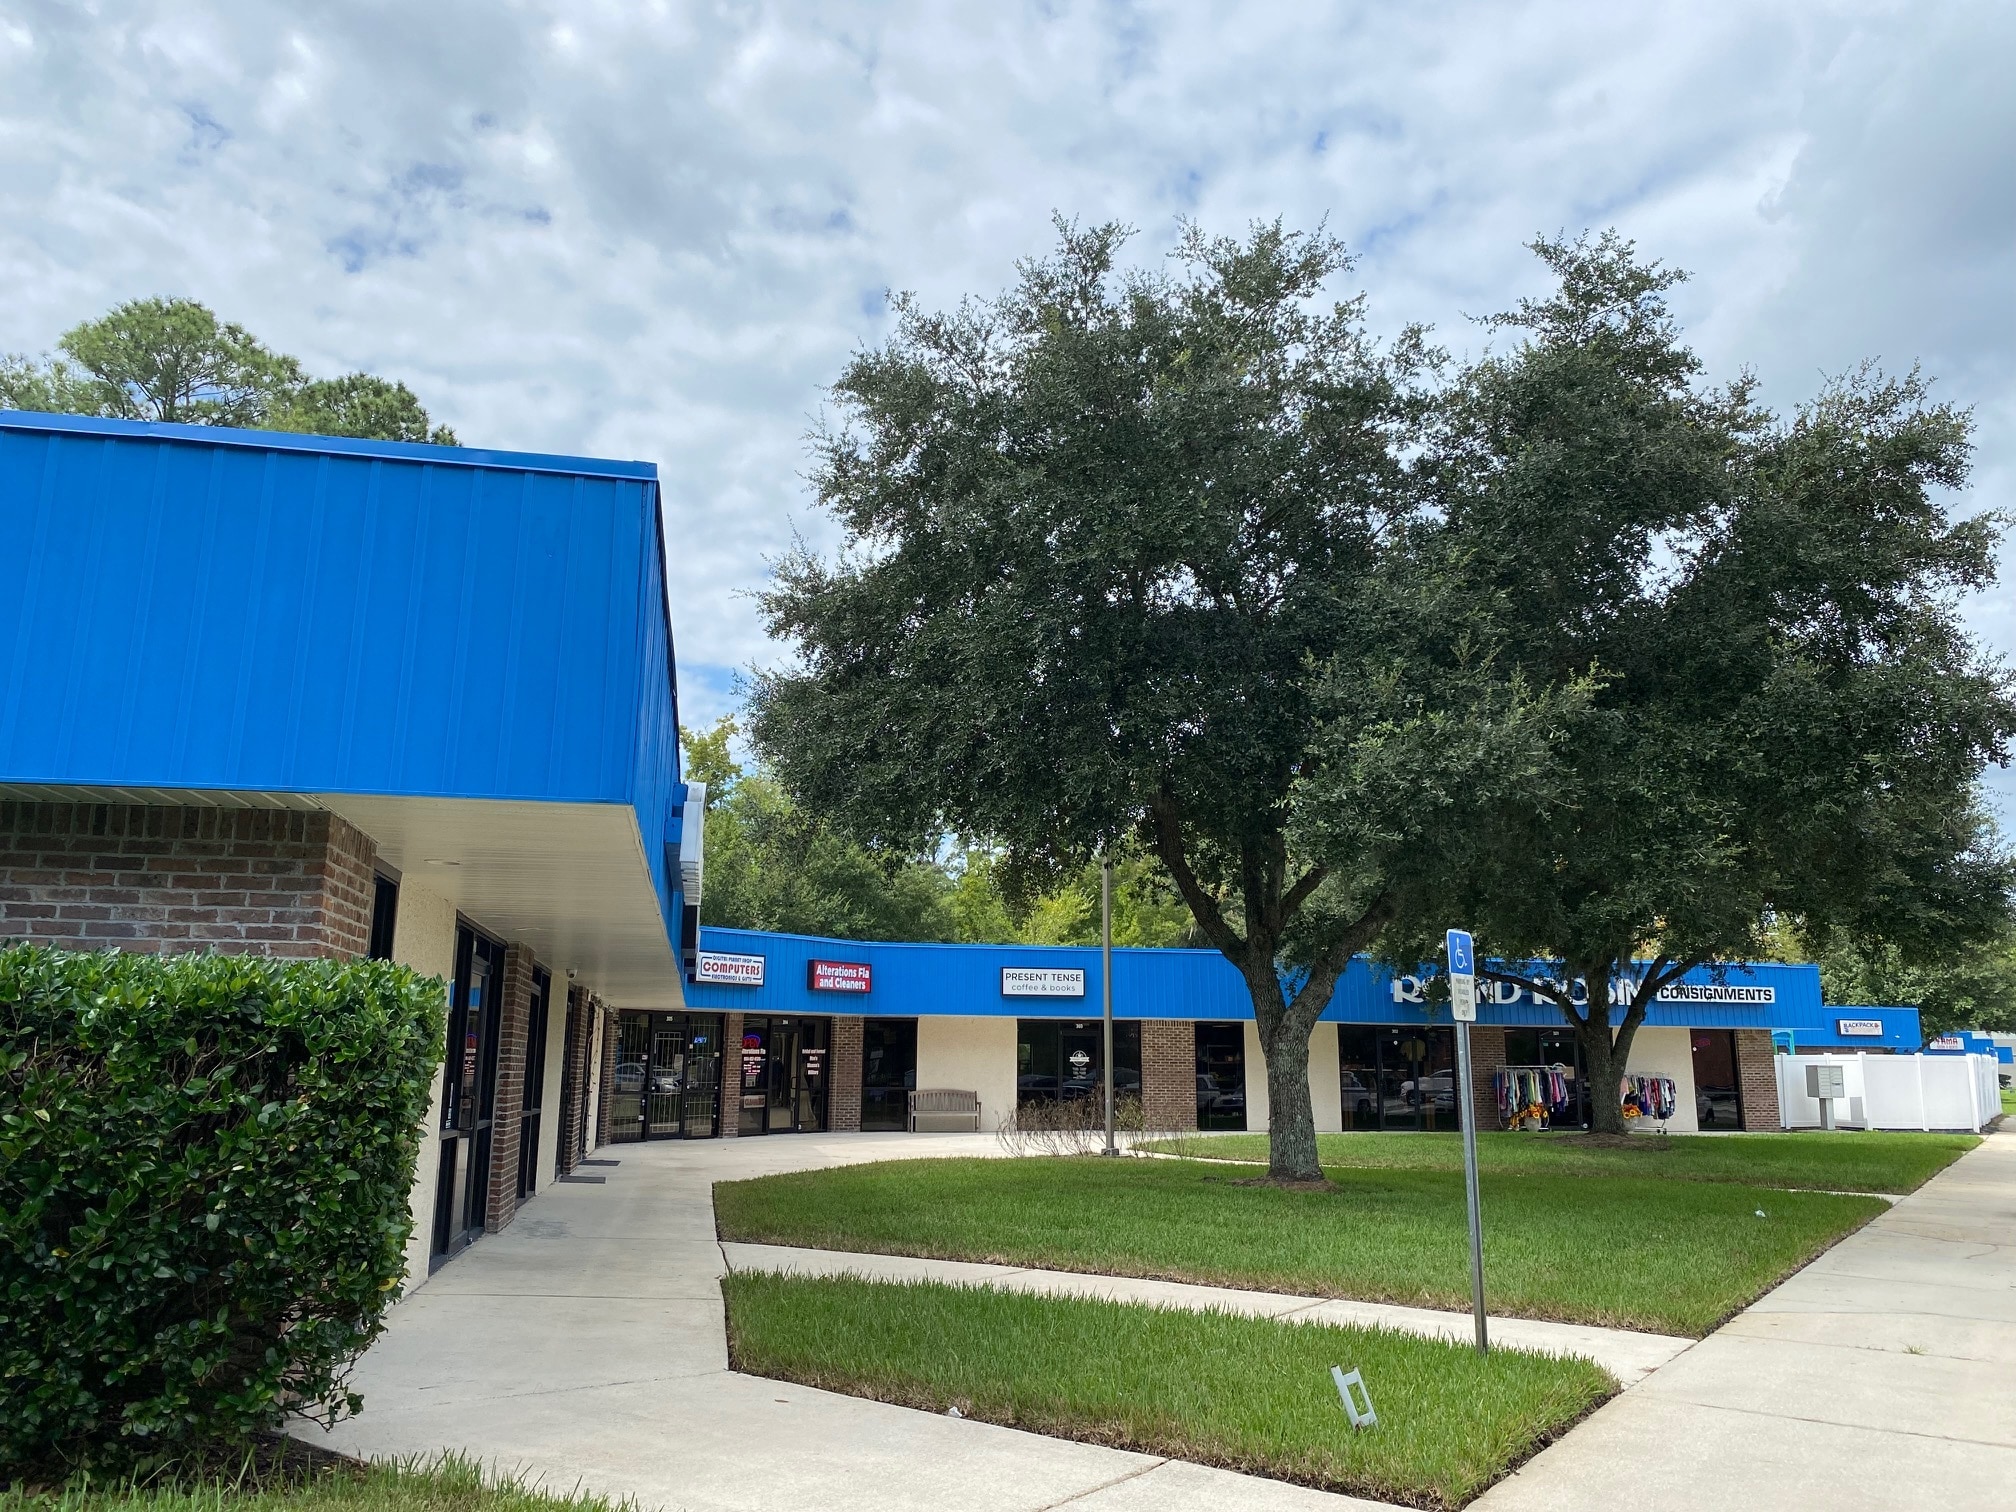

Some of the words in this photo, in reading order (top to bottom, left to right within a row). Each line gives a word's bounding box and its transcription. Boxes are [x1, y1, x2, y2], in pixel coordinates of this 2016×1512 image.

[703, 961, 760, 976] COMPUTERS
[816, 964, 857, 978] Alterations
[858, 967, 870, 978] Fla
[819, 976, 833, 988] and
[834, 977, 866, 989] Cleaners
[1005, 972, 1048, 981] PRESENT
[1051, 973, 1081, 982] TENSE
[1011, 983, 1039, 992] coffee
[1049, 984, 1076, 992] books
[1660, 987, 1773, 1001] CONSIGNMENTS
